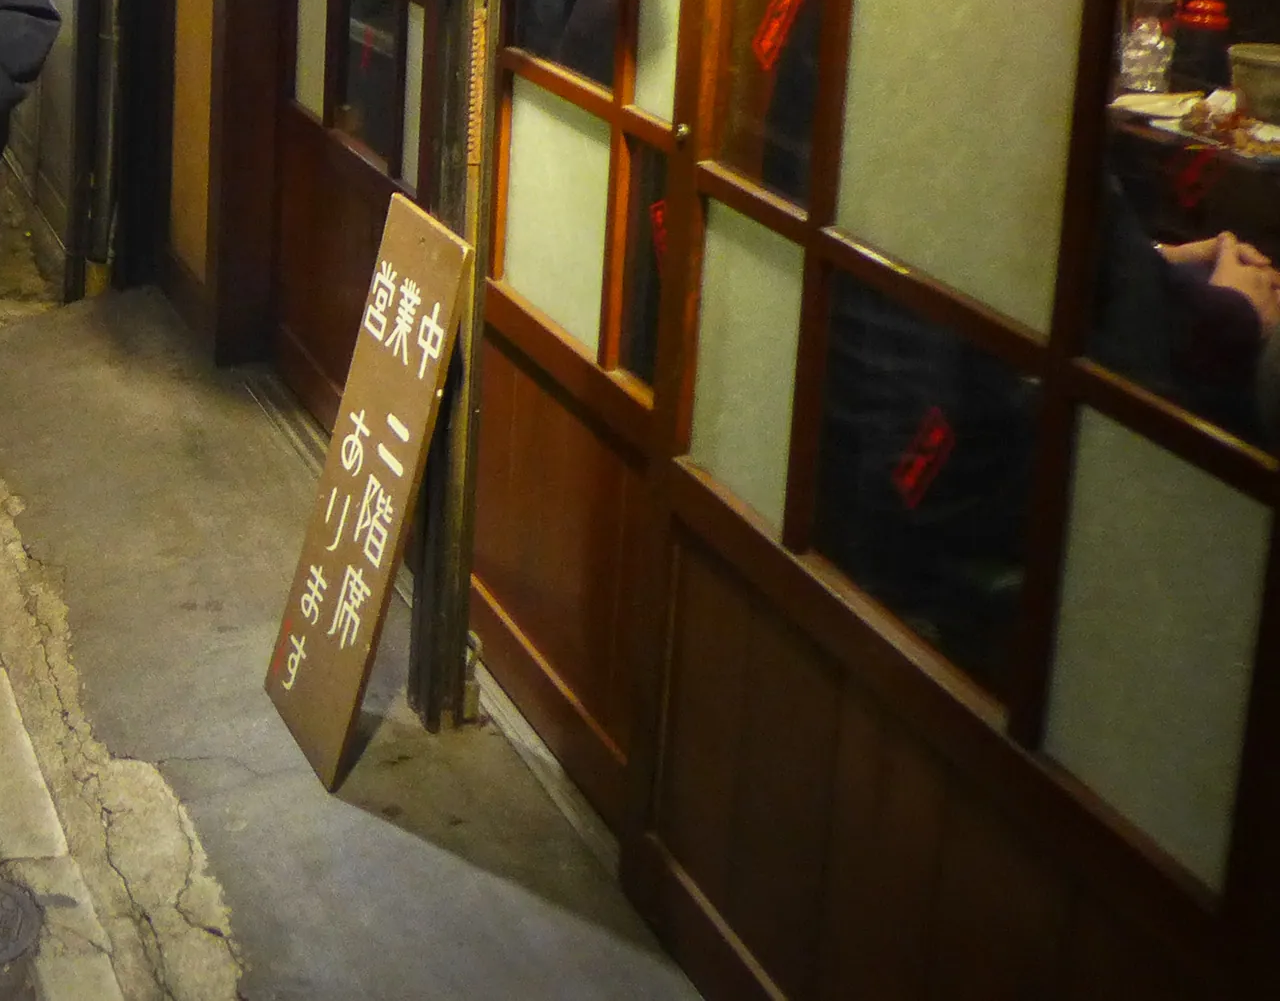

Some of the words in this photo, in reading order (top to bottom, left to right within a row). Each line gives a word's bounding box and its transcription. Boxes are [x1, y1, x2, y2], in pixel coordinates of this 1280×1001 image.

[365, 260, 444, 379] 営業中
[282, 409, 370, 690] あります
[327, 412, 410, 649] 二階席
